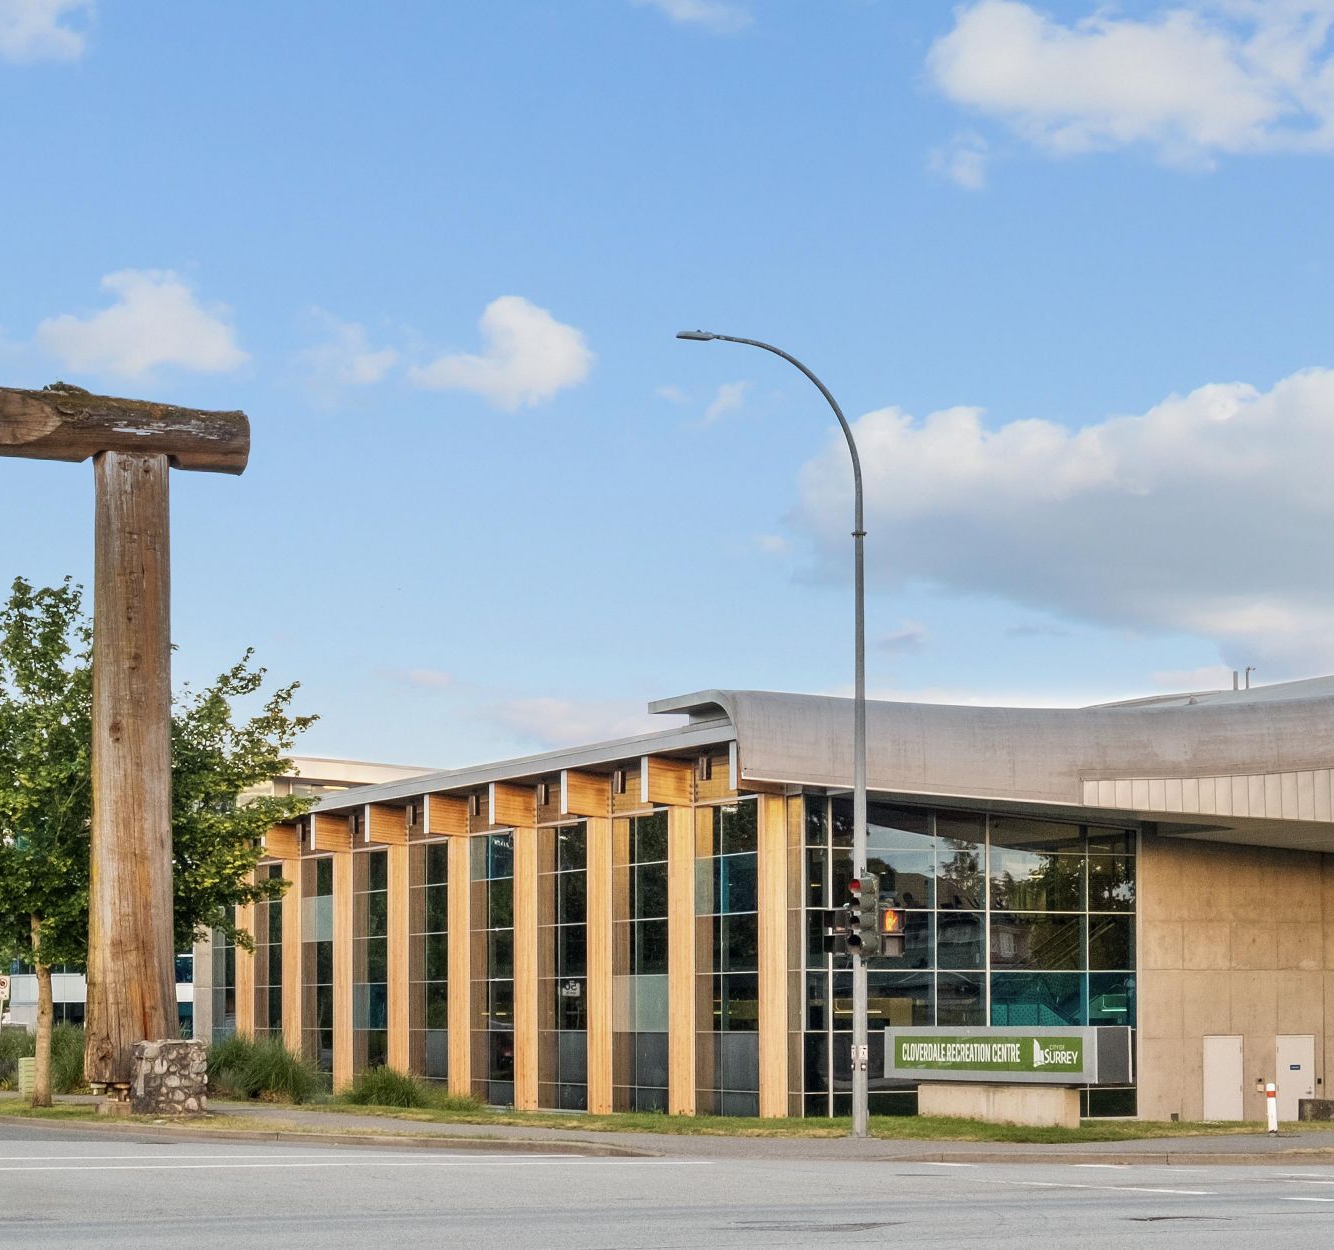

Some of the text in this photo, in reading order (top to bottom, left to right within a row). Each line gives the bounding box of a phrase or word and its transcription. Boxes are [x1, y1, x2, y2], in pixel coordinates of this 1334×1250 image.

[902, 1043, 1021, 1063] CLOVERDALE RECREATION CENTRE
[1044, 1048, 1079, 1064] SURREY
